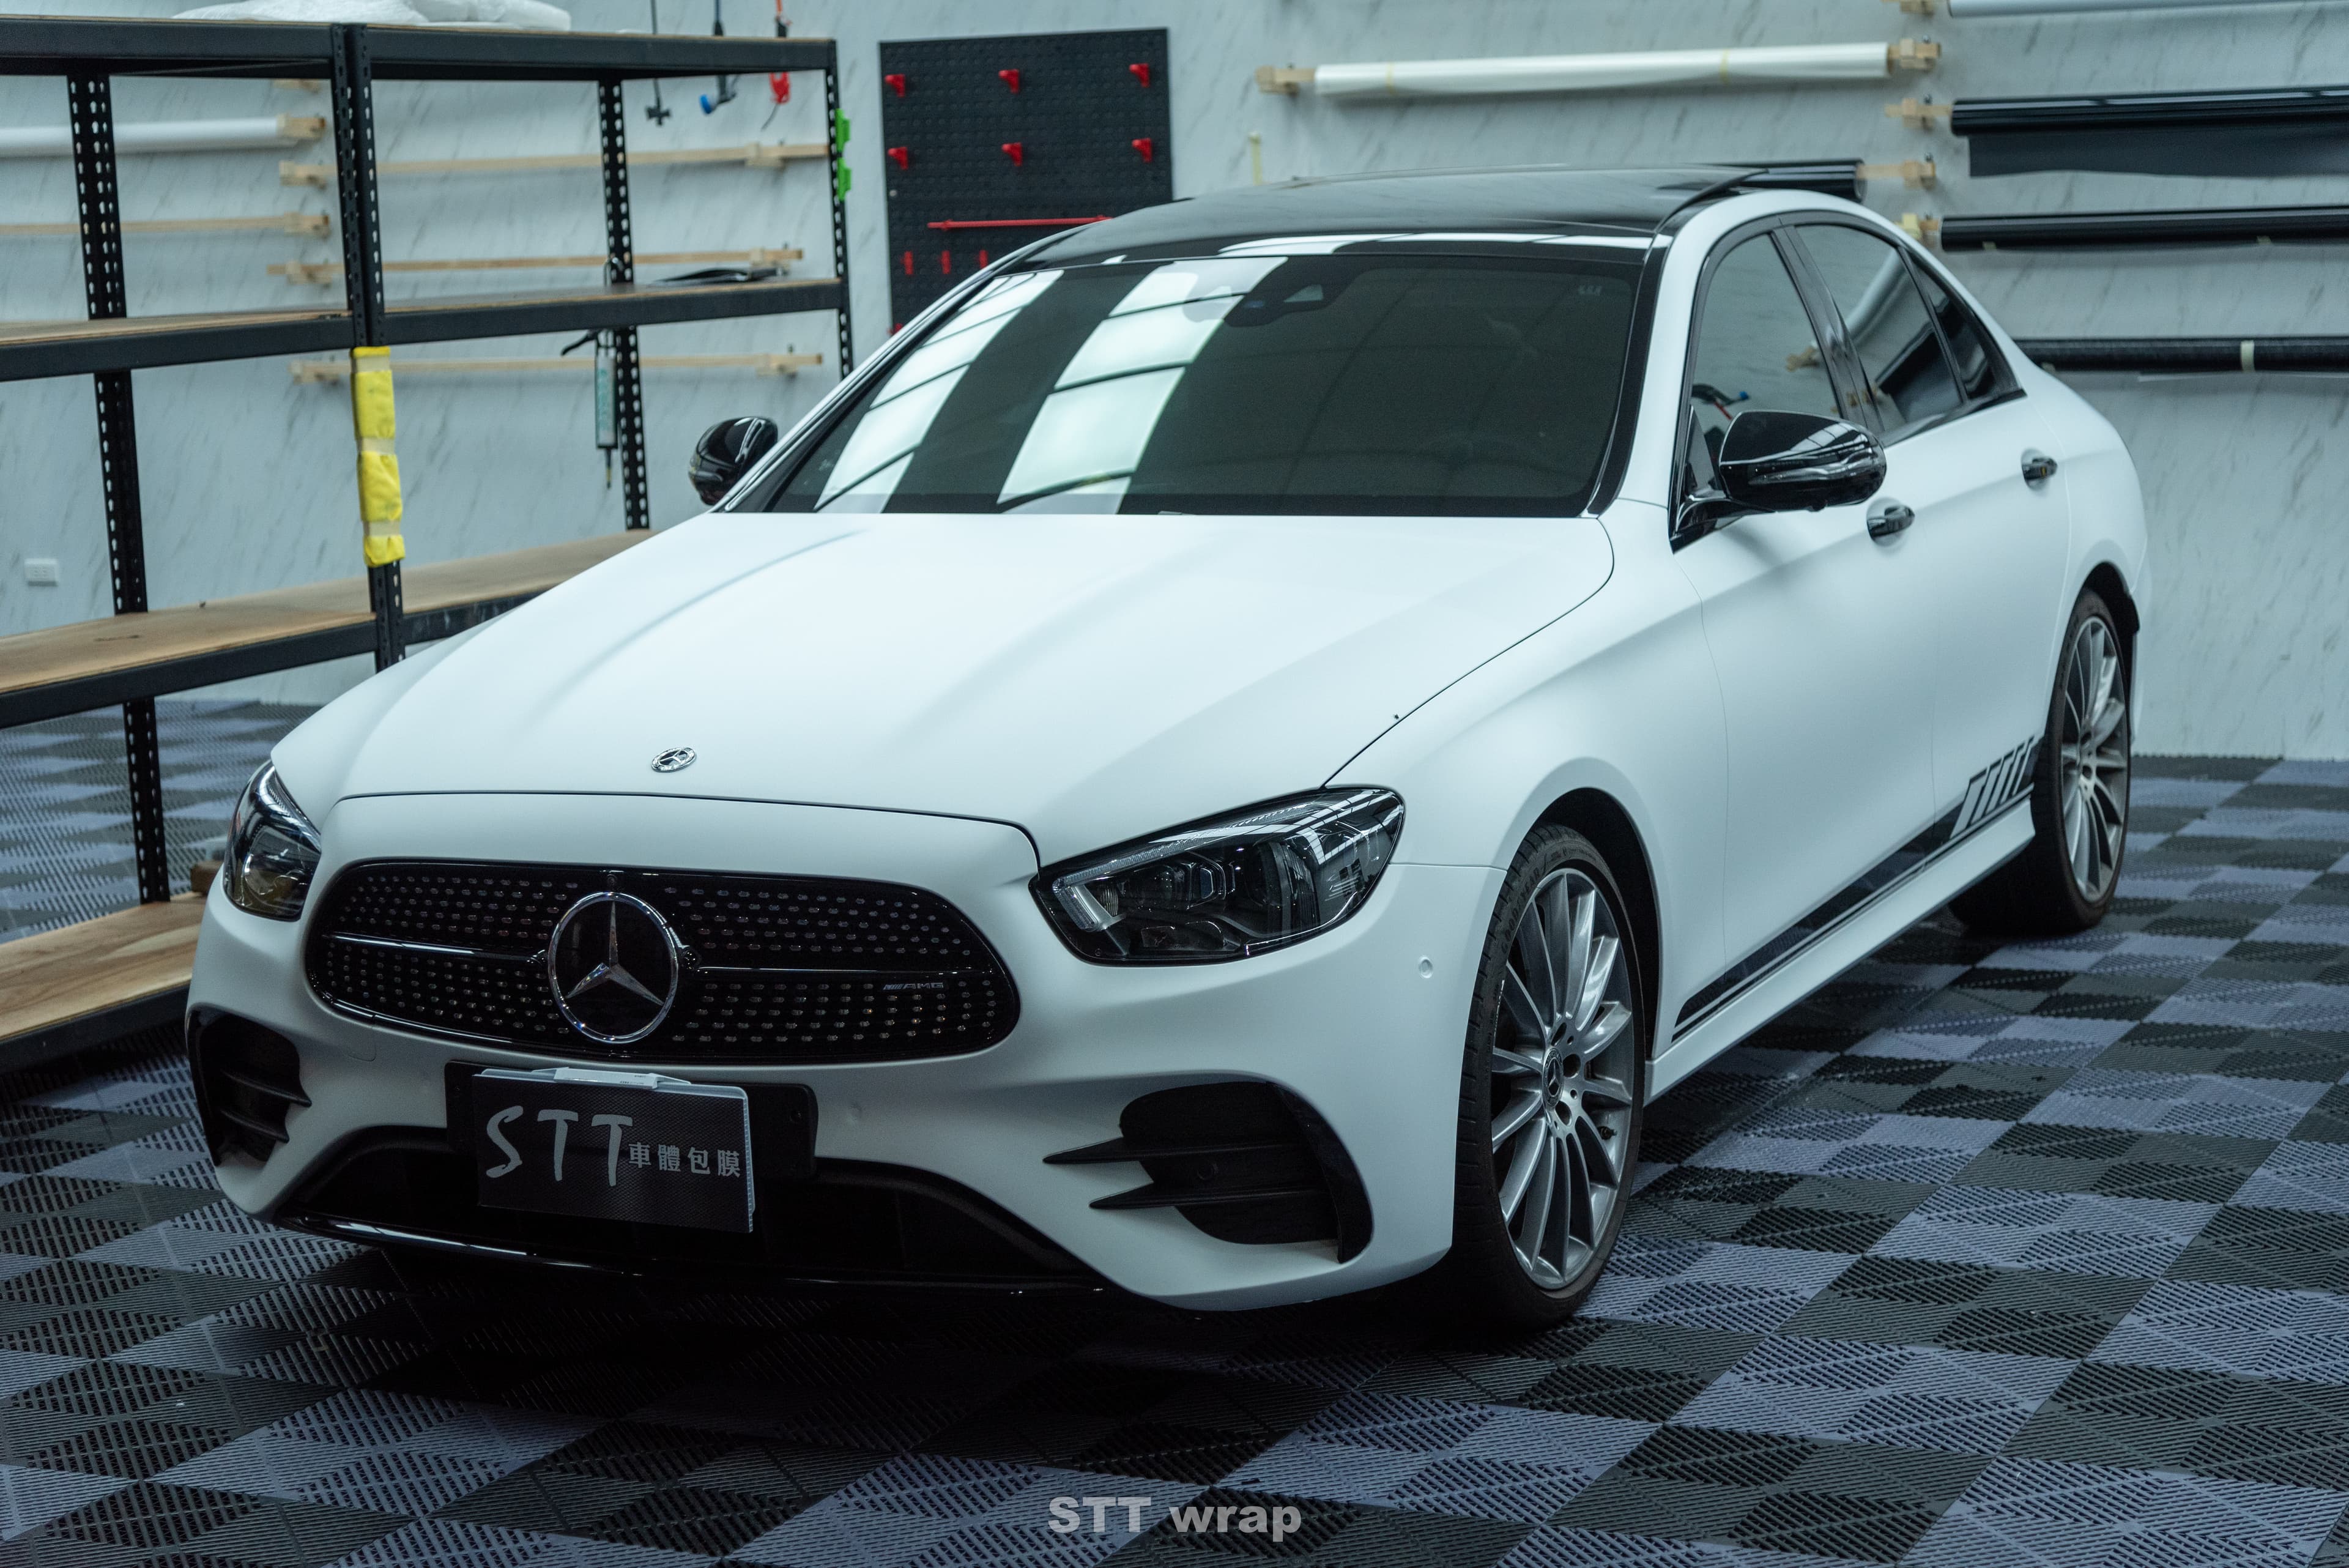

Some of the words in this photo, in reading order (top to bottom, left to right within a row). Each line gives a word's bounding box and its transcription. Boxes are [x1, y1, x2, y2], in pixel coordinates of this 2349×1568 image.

[486, 1105, 633, 1186] STT
[628, 1142, 741, 1178] 車體包膜
